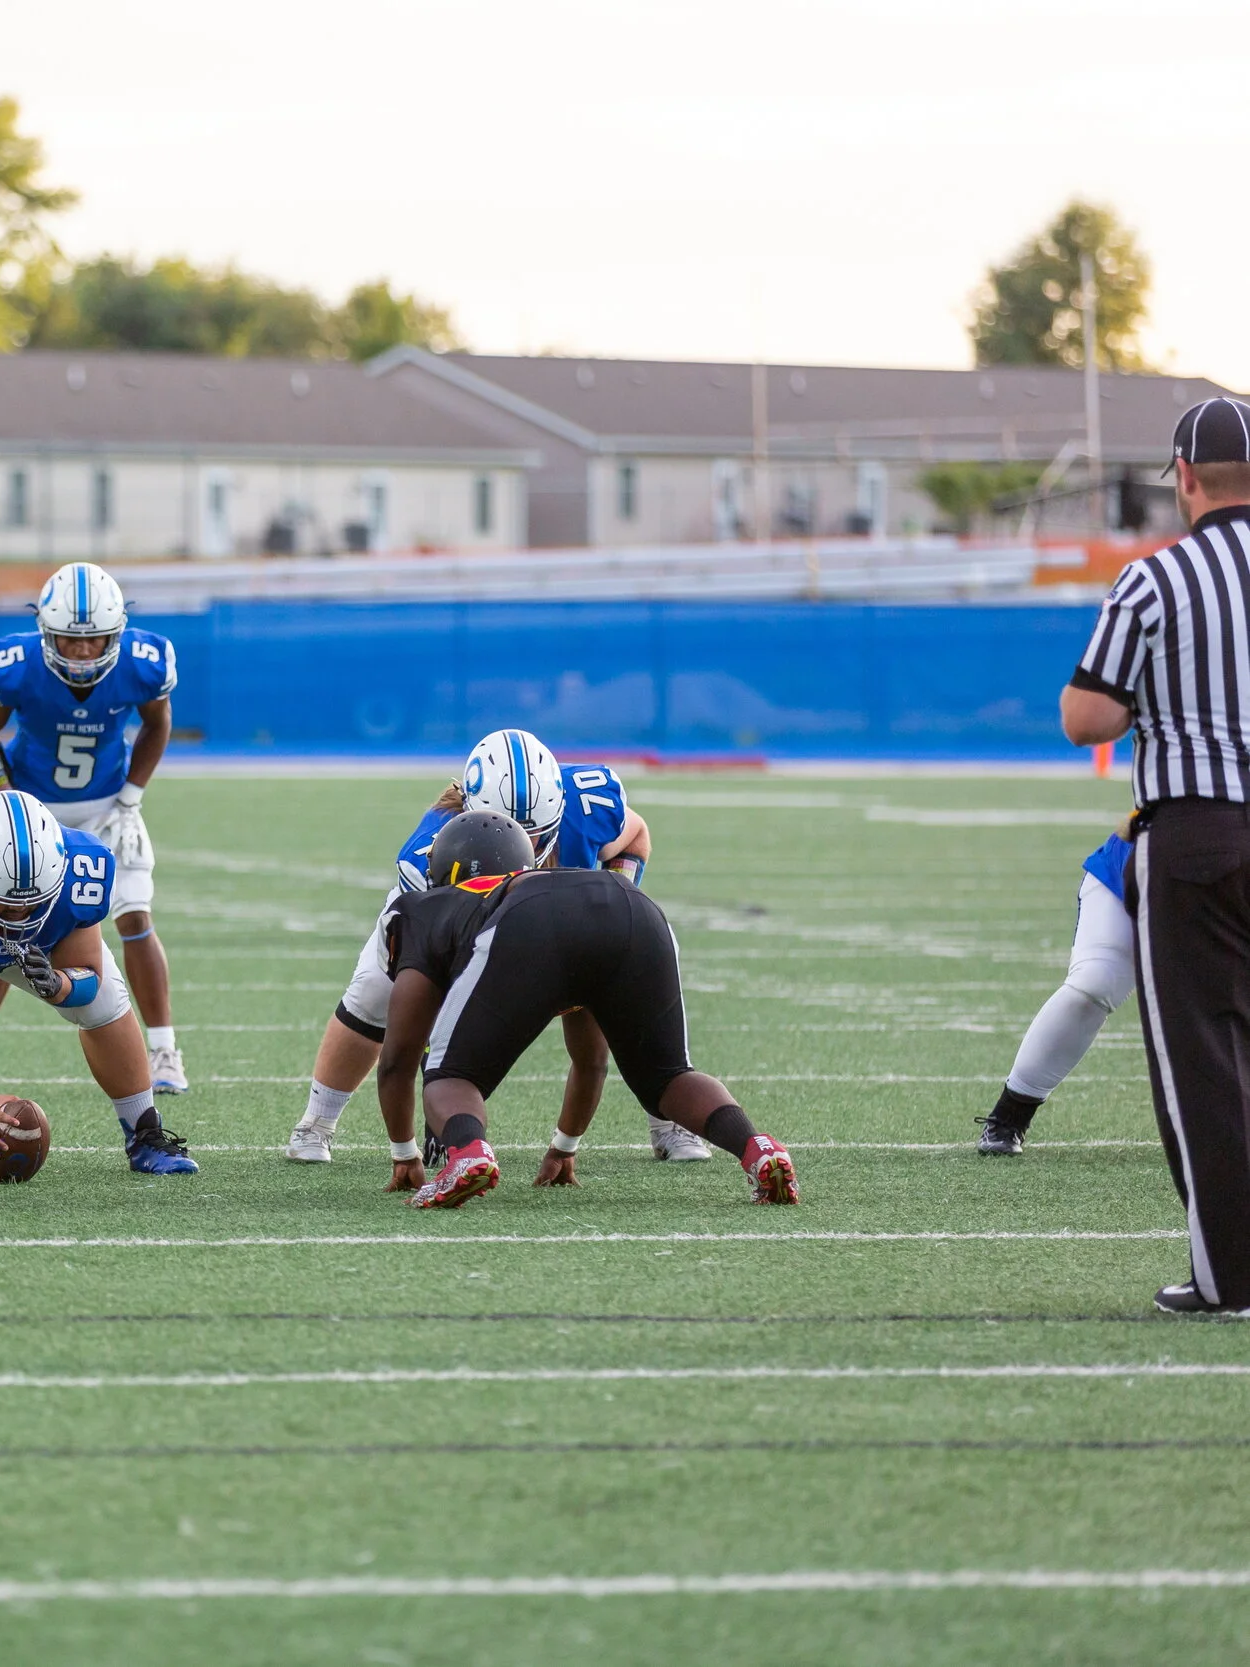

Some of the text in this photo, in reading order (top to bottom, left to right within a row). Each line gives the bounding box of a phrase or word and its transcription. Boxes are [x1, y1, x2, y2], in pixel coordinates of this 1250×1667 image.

[131, 641, 160, 663] 5
[54, 734, 98, 789] 5
[572, 769, 616, 816] 70
[70, 853, 107, 906] 62
